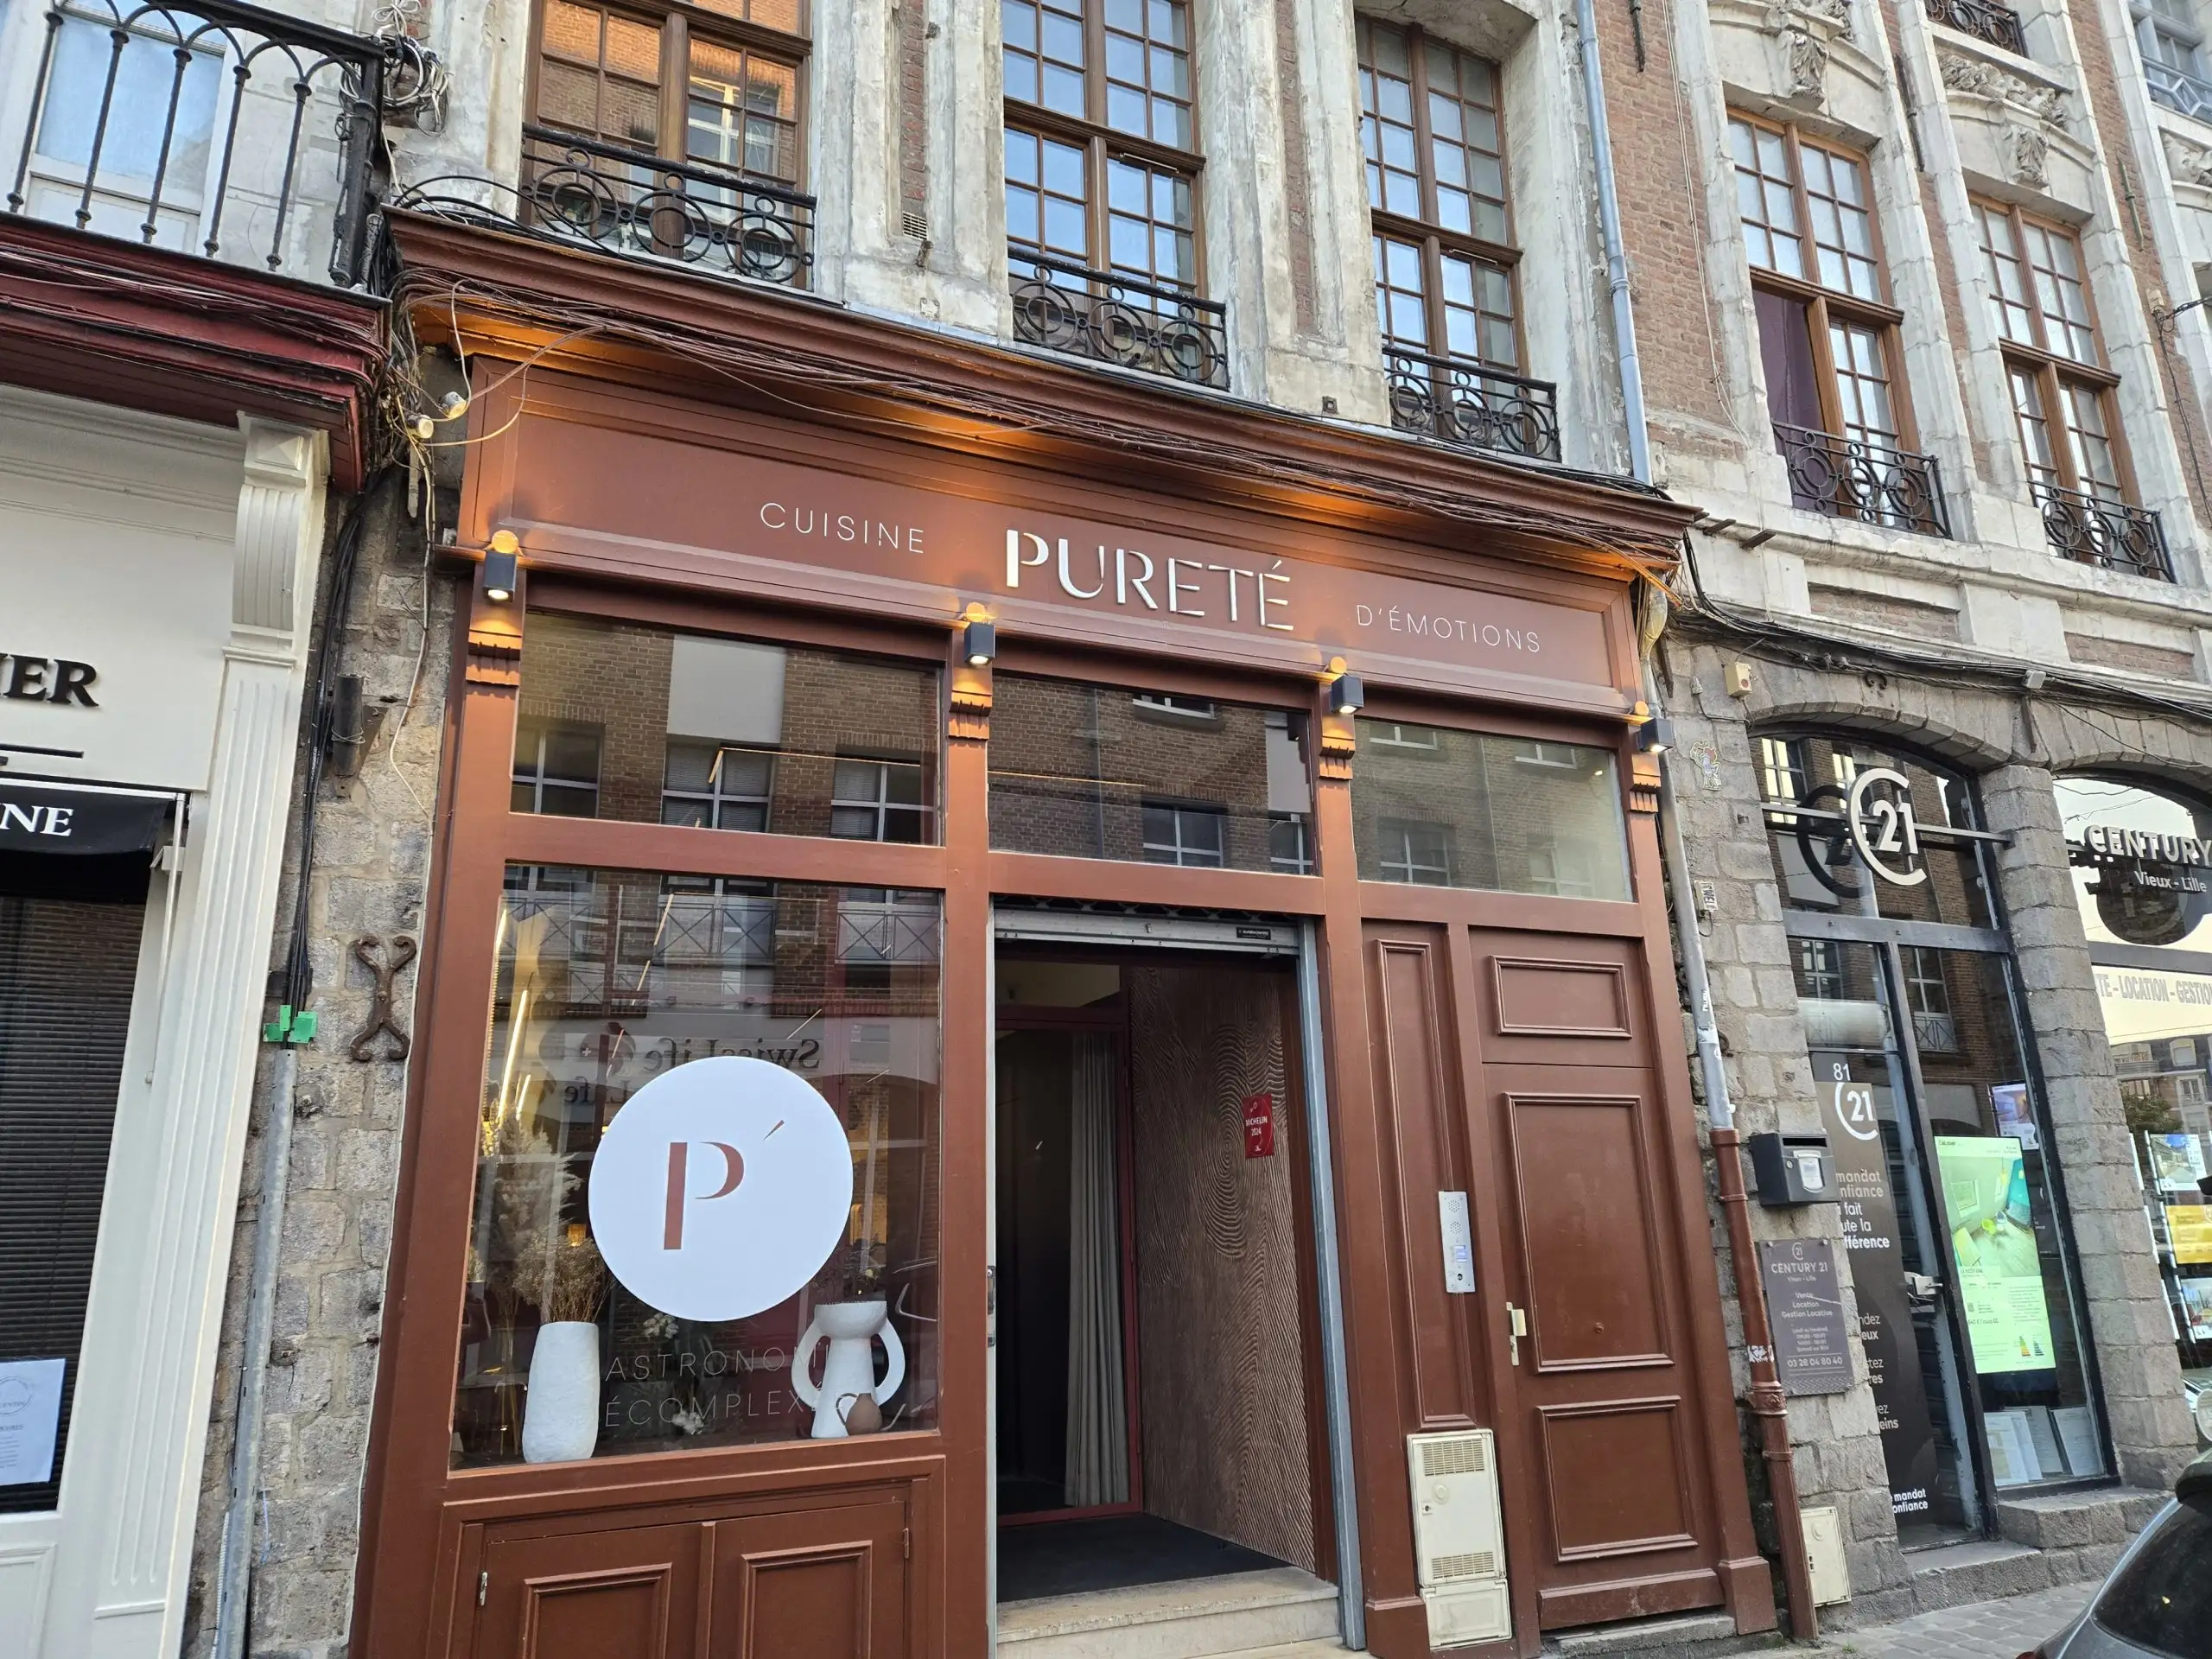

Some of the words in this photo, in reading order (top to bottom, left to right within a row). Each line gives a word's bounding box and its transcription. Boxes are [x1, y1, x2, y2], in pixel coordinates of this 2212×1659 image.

[760, 502, 924, 554] CUISINE
[1007, 529, 1294, 631] PURETÉ
[1357, 604, 1540, 653] D'ÉMOTIONS
[2084, 824, 2212, 867] CENTURY
[2133, 870, 2172, 888] Vieux
[2181, 876, 2207, 892] Lille
[2118, 976, 2170, 1001] LOCATION
[1833, 1063, 1851, 1081] 81
[1245, 1116, 1268, 1127] MICHELIN
[1835, 1168, 1882, 1183] mandat
[1859, 1217, 1872, 1232] la
[1770, 1262, 1816, 1274] CENTURY
[1819, 1262, 1828, 1273] 21
[1787, 1359, 1797, 1368] 03
[1798, 1358, 1809, 1367] 28
[1809, 1357, 1820, 1366] 04
[1832, 1356, 1843, 1364] 40
[605, 1381, 823, 1427] ÉCOMPLEX
[1893, 1488, 1927, 1503] mandat
